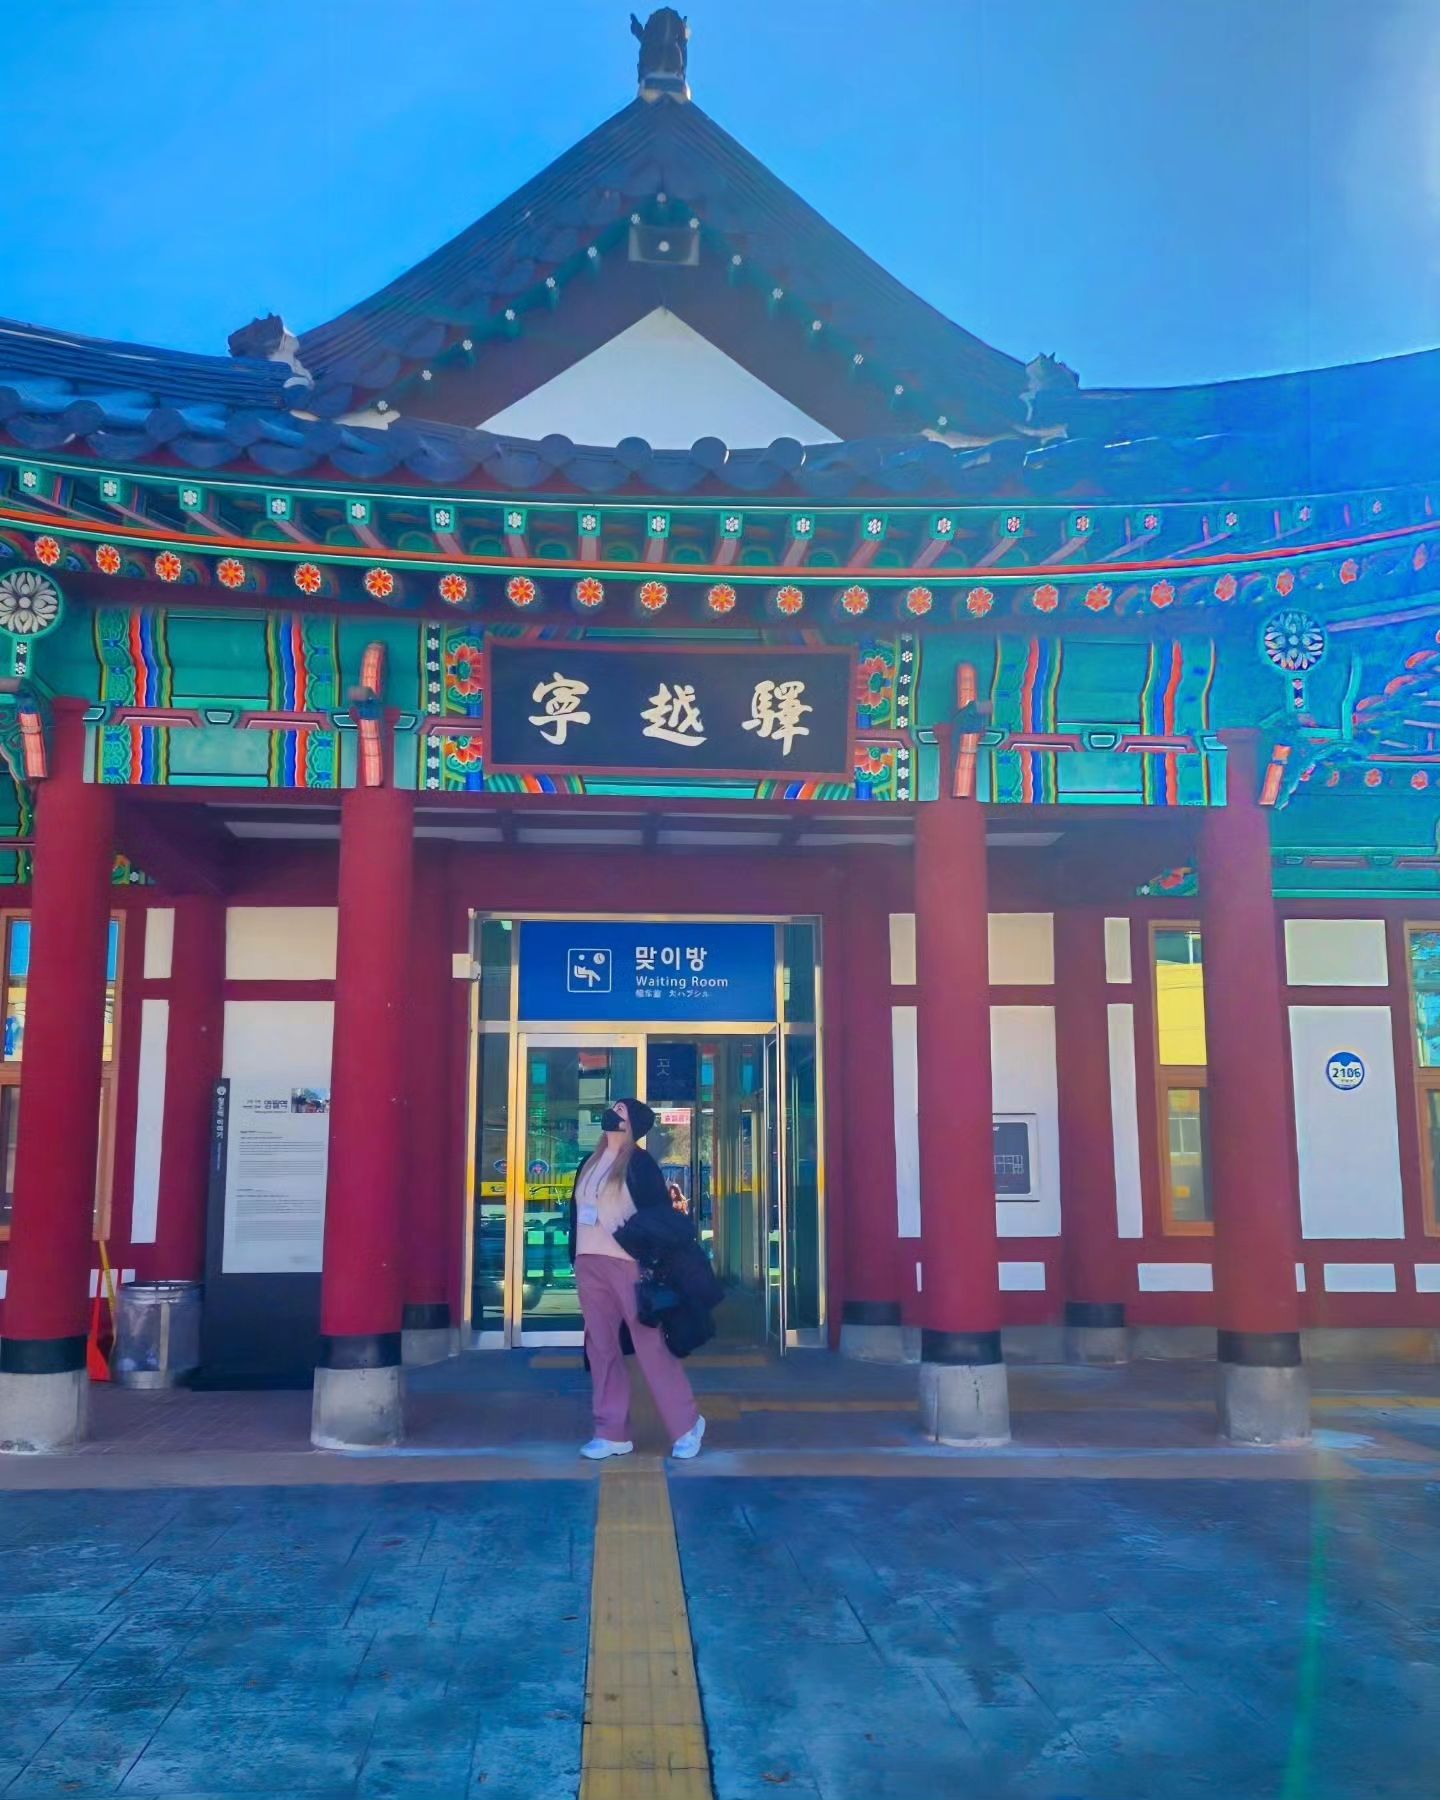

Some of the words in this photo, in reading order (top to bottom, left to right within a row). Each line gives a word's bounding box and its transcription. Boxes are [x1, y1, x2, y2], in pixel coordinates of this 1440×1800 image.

[635, 946, 708, 972] 맞이방
[635, 976, 687, 990] Waiting
[691, 976, 729, 988] Room
[1332, 1067, 1361, 1078] 2106
